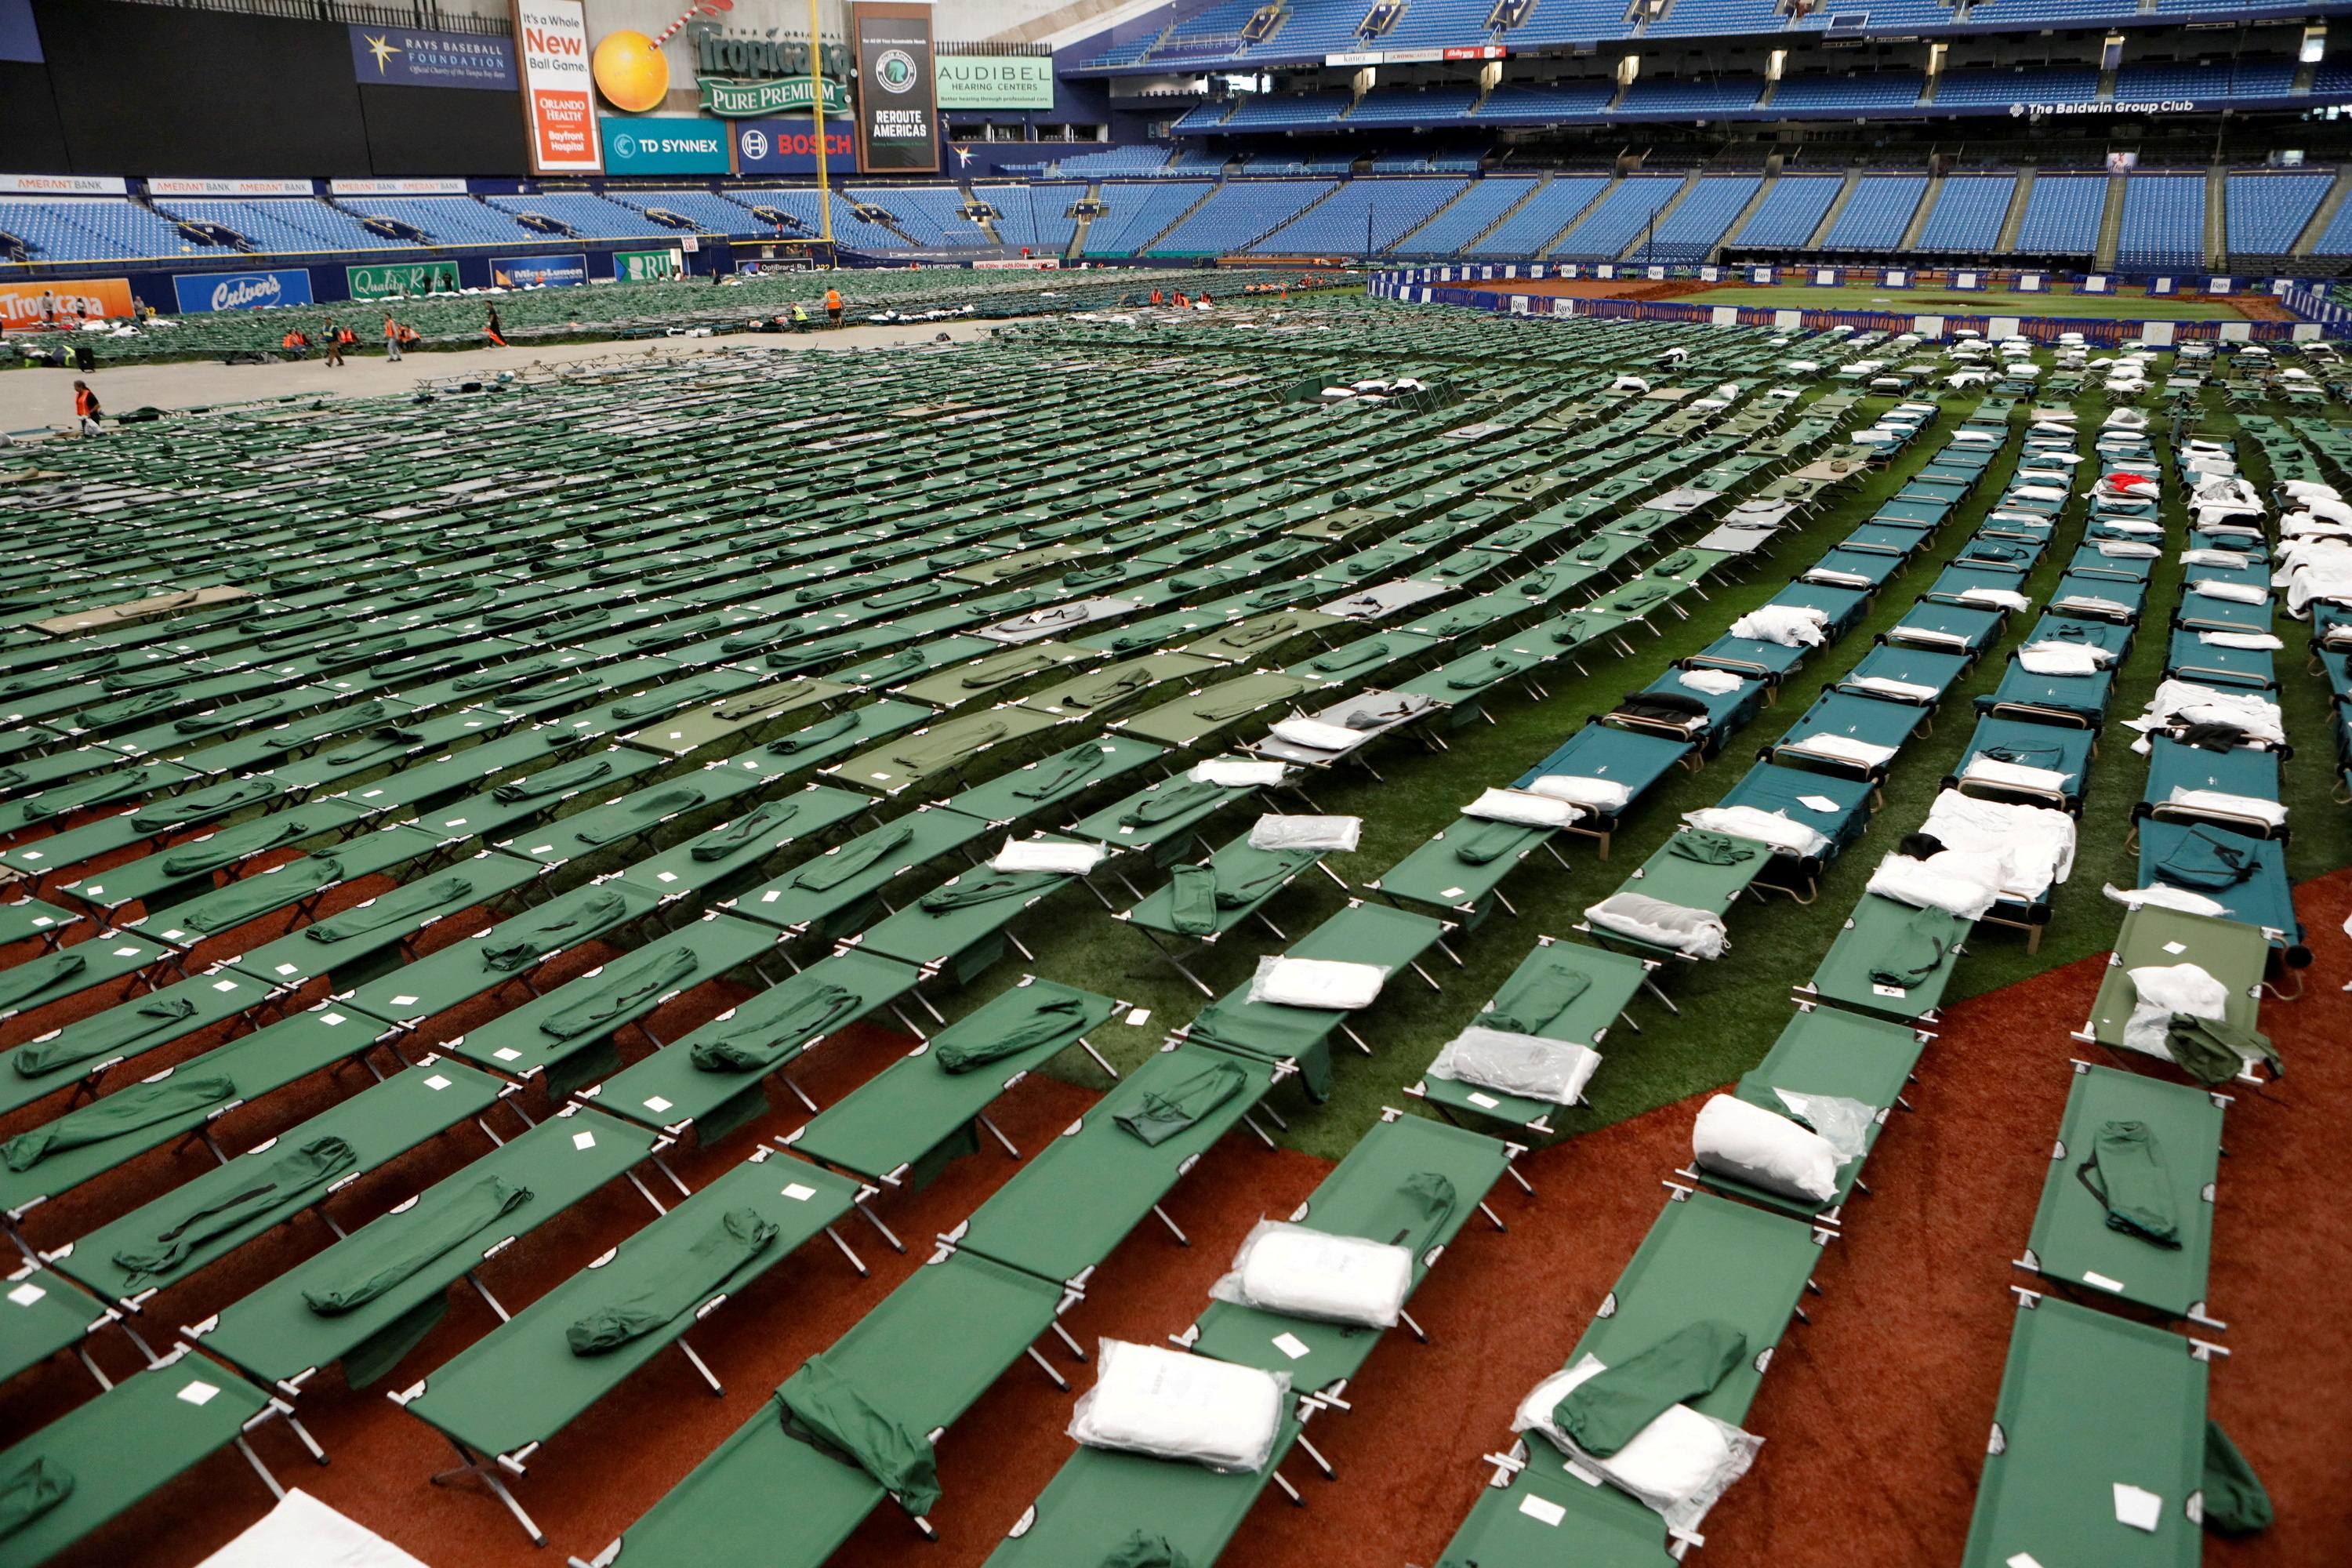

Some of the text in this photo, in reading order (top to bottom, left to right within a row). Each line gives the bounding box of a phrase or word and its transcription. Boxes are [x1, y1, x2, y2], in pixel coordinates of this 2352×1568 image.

[523, 13, 539, 24] It's
[549, 15, 580, 28] Whole
[728, 27, 758, 36] THE
[784, 31, 842, 39] ORIGNAL
[405, 38, 503, 56] RAYS BASEBALL
[525, 27, 582, 56] New
[687, 21, 851, 78] Tropicana
[408, 53, 504, 69] FOUNDATION
[529, 57, 587, 72] Ball Game.
[409, 65, 430, 75] Official
[430, 67, 450, 76] Charity
[938, 66, 1051, 81] AUDIBEL
[712, 82, 835, 110] PURE PREMIUM
[539, 97, 586, 111] ORLANDO
[2028, 100, 2194, 114] The Baldwin Group Club
[546, 110, 582, 121] HEALTH
[876, 110, 922, 123] REROUTE
[548, 130, 585, 142] Bayfront
[873, 124, 927, 137] AMERICAS
[550, 141, 585, 154] Hospital
[639, 139, 718, 153] TD SYNNEX
[778, 134, 851, 154] BOSCH
[18, 179, 103, 190] AMERANT BANK
[157, 182, 230, 191] AMERANT BANK
[240, 183, 307, 192] AMERANT BANK
[336, 182, 397, 191] AMERANT BANK
[402, 182, 440, 191] AMERANT
[354, 267, 454, 296] Quality Rfin
[211, 274, 281, 312] Culver's
